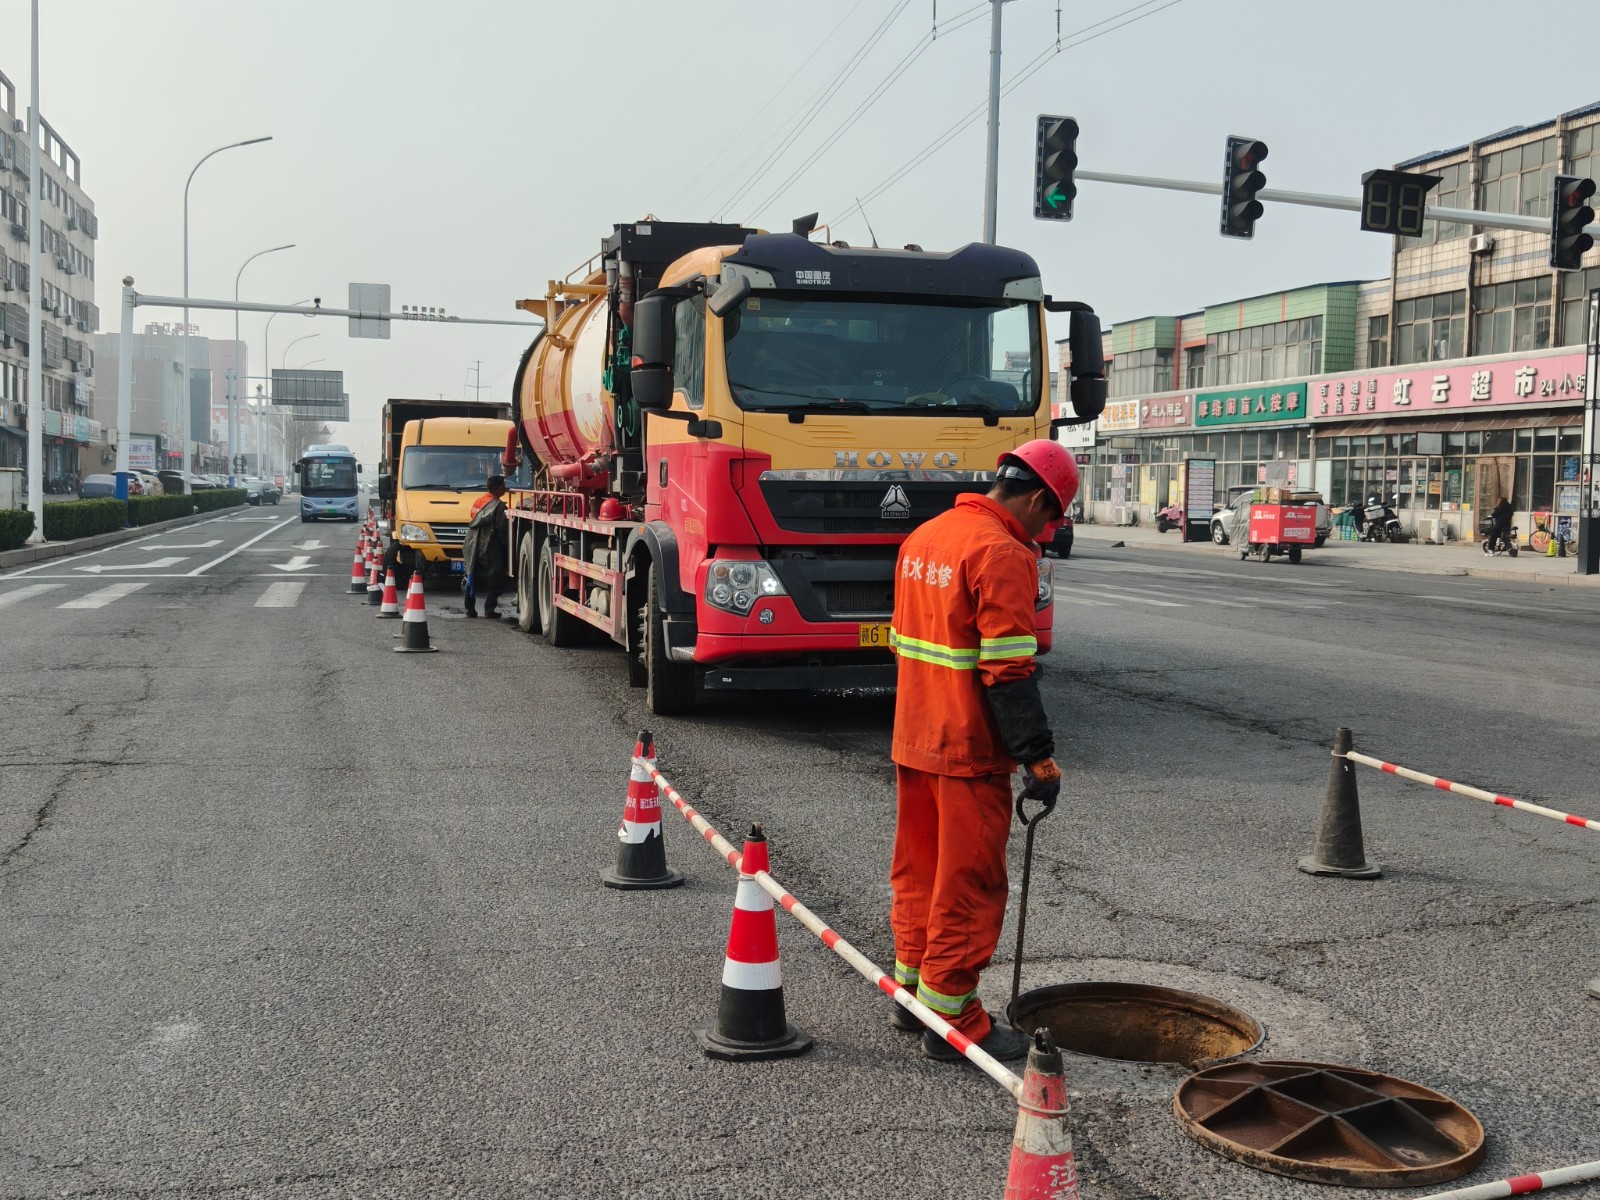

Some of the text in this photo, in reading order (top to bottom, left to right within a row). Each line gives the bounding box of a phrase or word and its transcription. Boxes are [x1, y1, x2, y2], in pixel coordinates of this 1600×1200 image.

[1393, 366, 1586, 405] 虹云超市 24小时
[1151, 402, 1182, 419] 成人用品
[834, 451, 959, 468] HOWO
